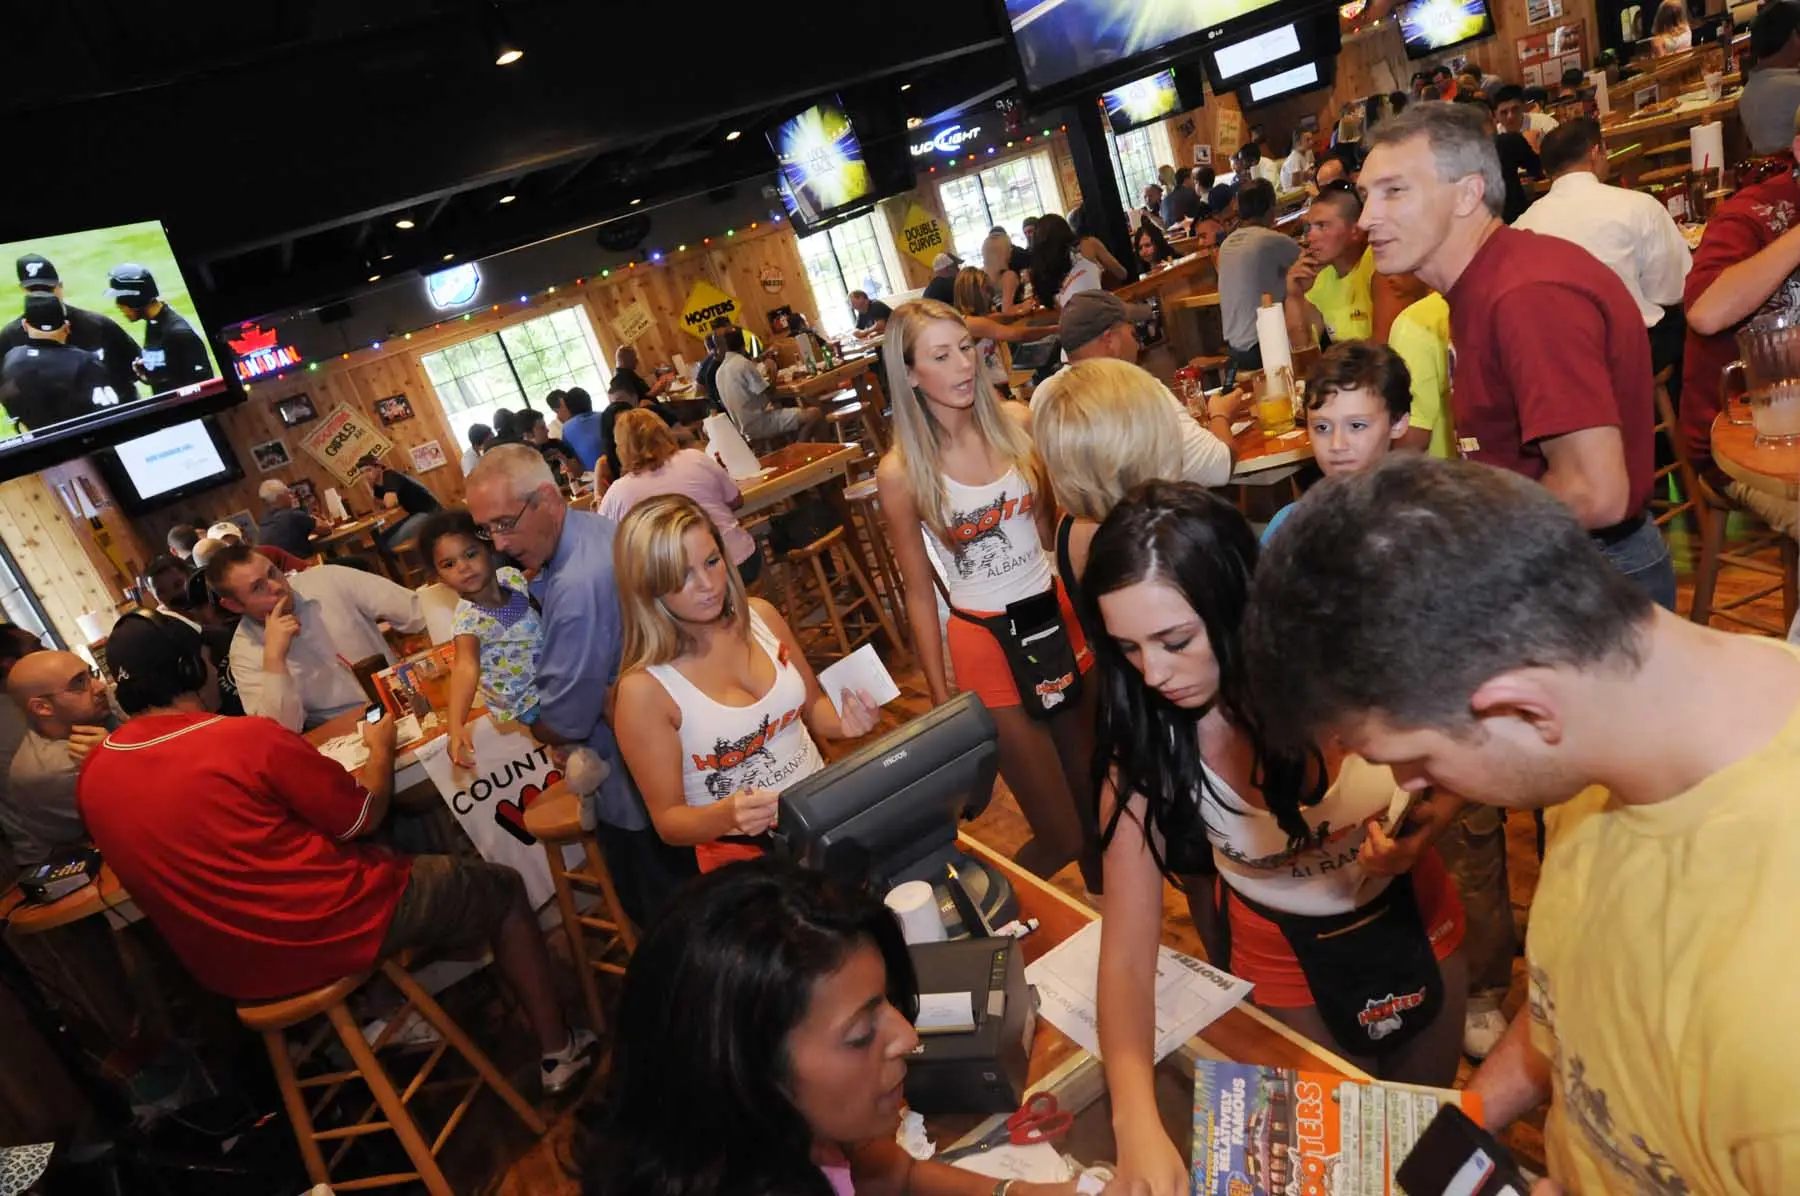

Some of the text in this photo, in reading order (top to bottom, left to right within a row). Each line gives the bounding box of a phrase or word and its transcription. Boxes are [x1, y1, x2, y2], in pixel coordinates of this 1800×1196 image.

[910, 127, 981, 156] UD LIGHT
[904, 220, 939, 241] DOUBLE
[909, 232, 942, 254] CURVES
[685, 299, 735, 326] HOOTERS
[233, 344, 302, 379] ANADIAN
[325, 422, 356, 457] GIRLS
[691, 704, 803, 772] HOOTE
[452, 744, 549, 815] COUNT
[1231, 1078, 1246, 1146] FAMOUS
[1219, 1089, 1232, 1172] RELATIVELY
[1295, 1080, 1326, 1196] OOTERS
